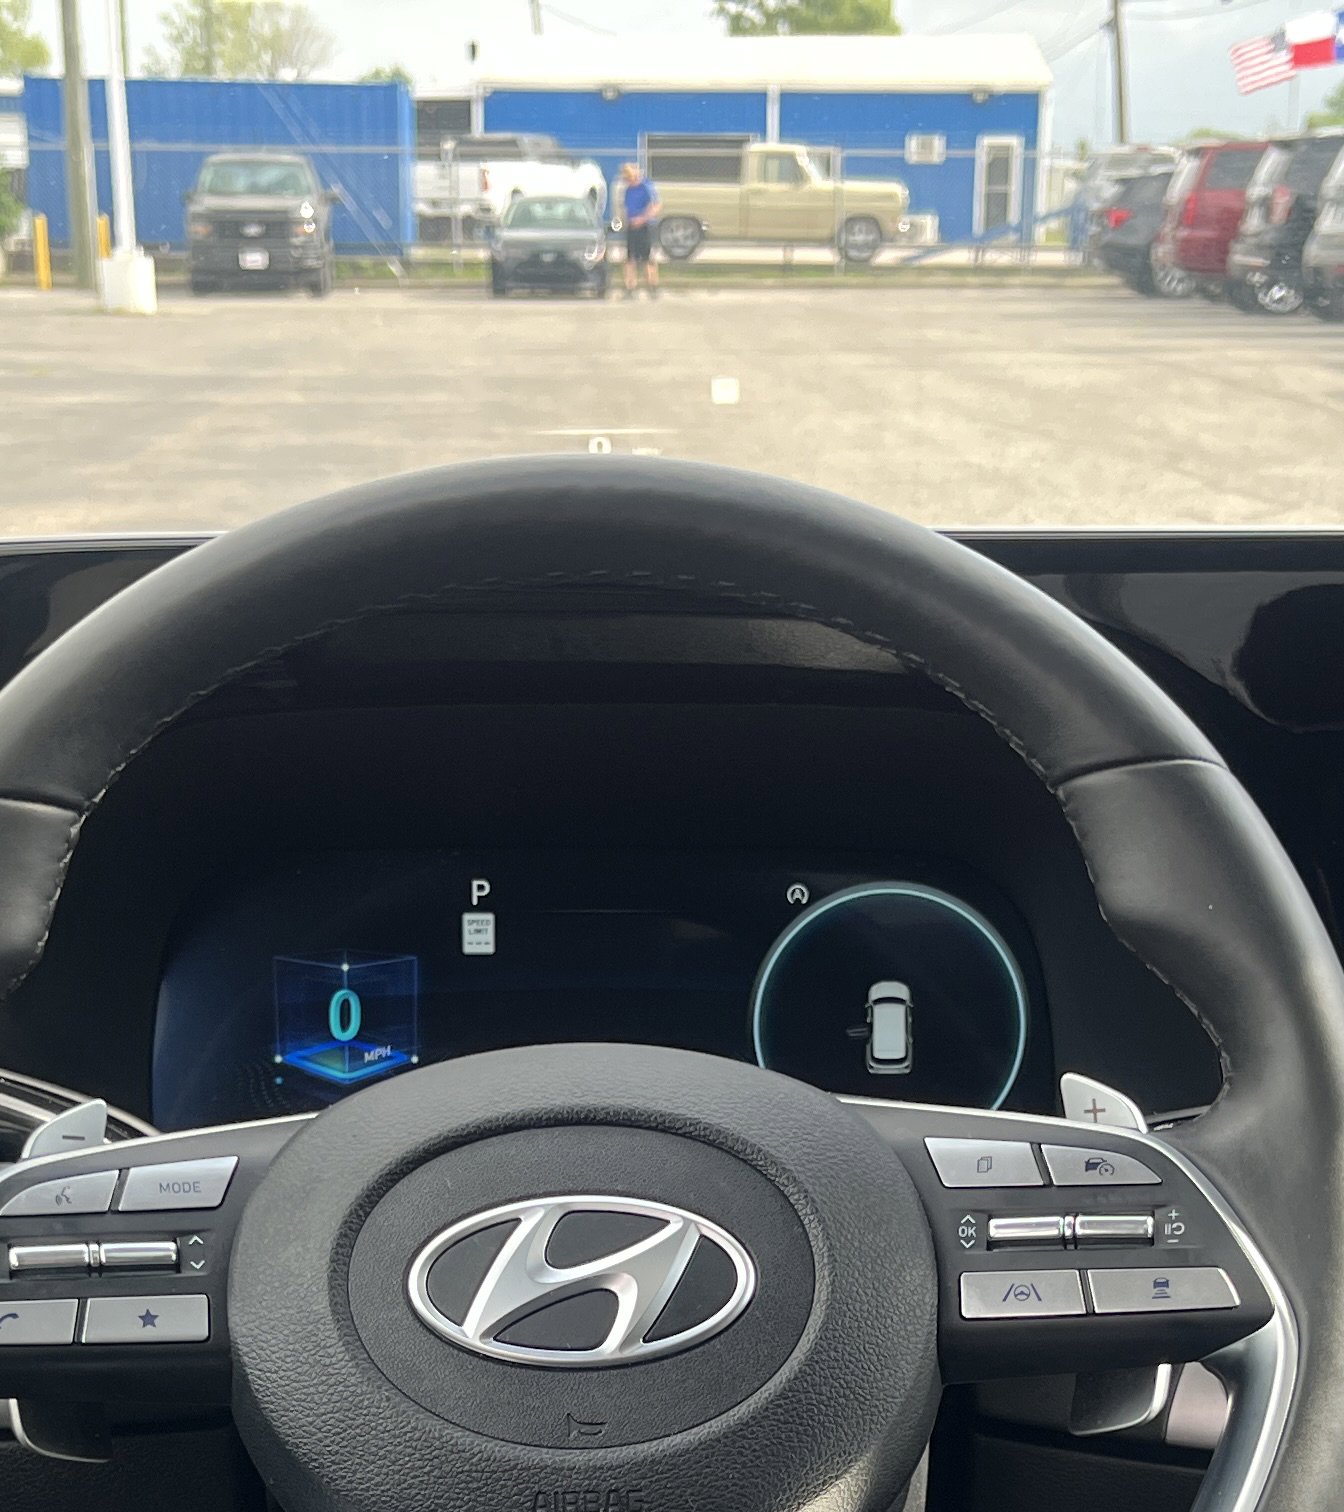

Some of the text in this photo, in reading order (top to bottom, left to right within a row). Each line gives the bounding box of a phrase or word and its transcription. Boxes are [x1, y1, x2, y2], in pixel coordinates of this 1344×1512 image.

[471, 879, 491, 906] P
[328, 988, 362, 1042] 0
[363, 1045, 392, 1063] MPH
[159, 1180, 202, 1194] MODE
[958, 1225, 977, 1239] OK
